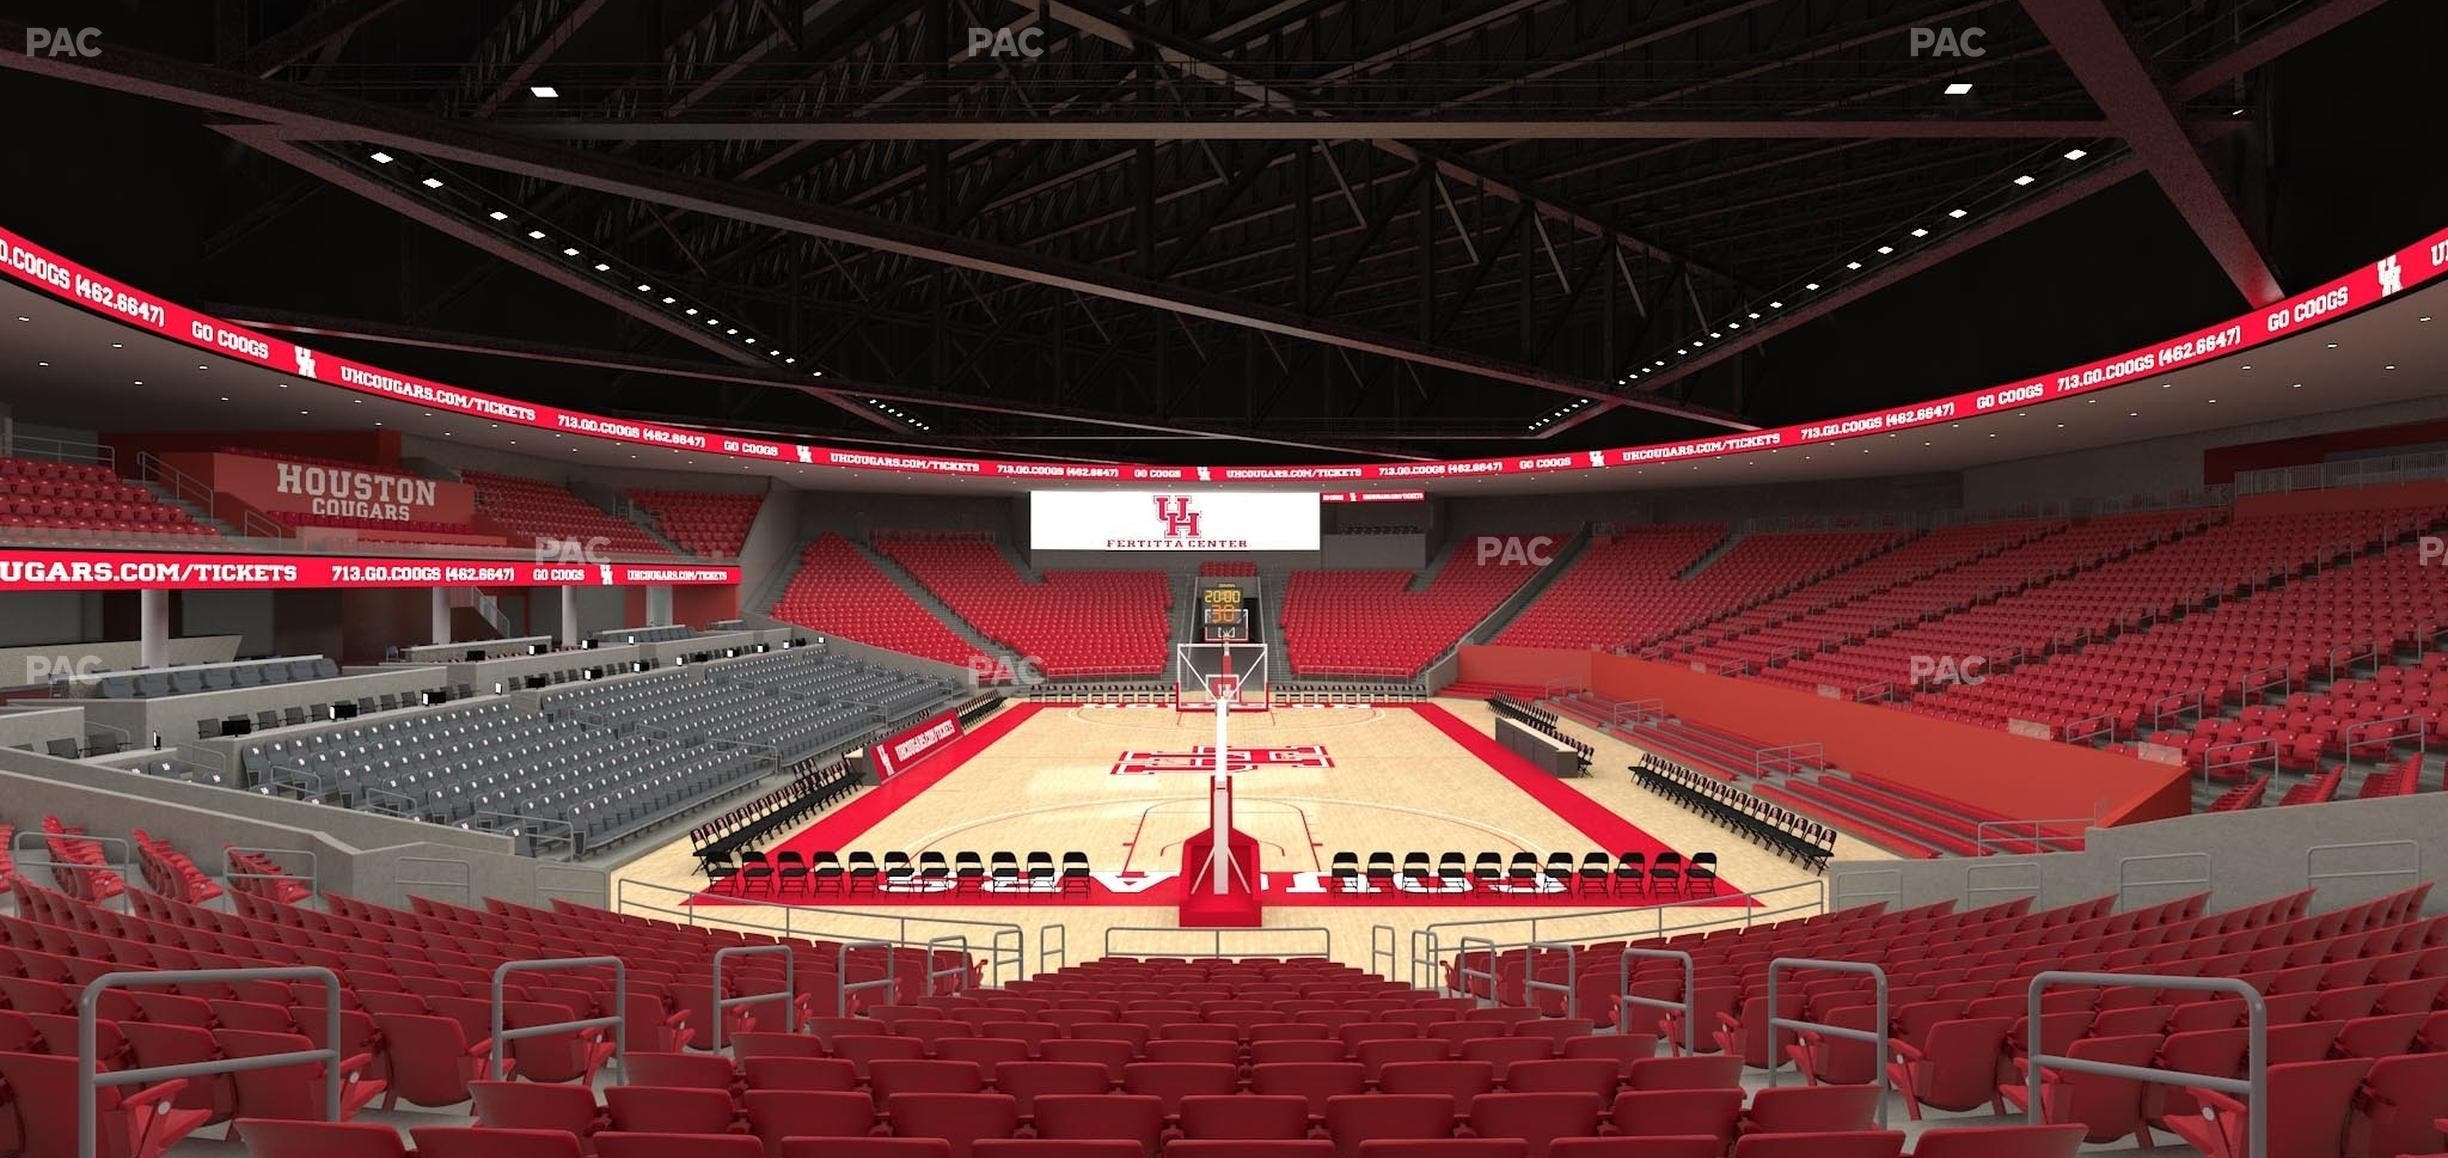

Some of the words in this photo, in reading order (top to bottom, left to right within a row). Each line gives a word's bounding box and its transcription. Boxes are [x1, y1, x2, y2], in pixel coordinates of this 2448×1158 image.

[2430, 239, 2448, 267] U
[75, 273, 165, 327] (462.6647)
[2268, 309, 2289, 332] GO
[2293, 286, 2349, 322] COOGS
[191, 320, 214, 342] GO
[217, 329, 269, 360] COOGS
[2057, 353, 2155, 392] 713.GO.COOGS
[2158, 325, 2241, 367] (462.6647)
[340, 365, 536, 421] UHCOUGARS.COM/TICKETS
[1976, 394, 1995, 410] GO
[1998, 382, 2044, 405] COOGS
[557, 414, 640, 438] 713.GO.COOGS
[1801, 416, 1883, 440] 713.GO.COOGS
[724, 440, 739, 453] GO
[1622, 432, 1781, 462] UHCOUGARS.COM/TICKETS
[276, 462, 437, 507] HOUSTON
[312, 497, 410, 522] COUGARS
[1106, 539, 1184, 549] FERTITTA
[1188, 539, 1249, 549] CENTER
[0, 560, 298, 584] UGARS.COM/TICKETS
[331, 565, 442, 582] 713.GO.COOGS
